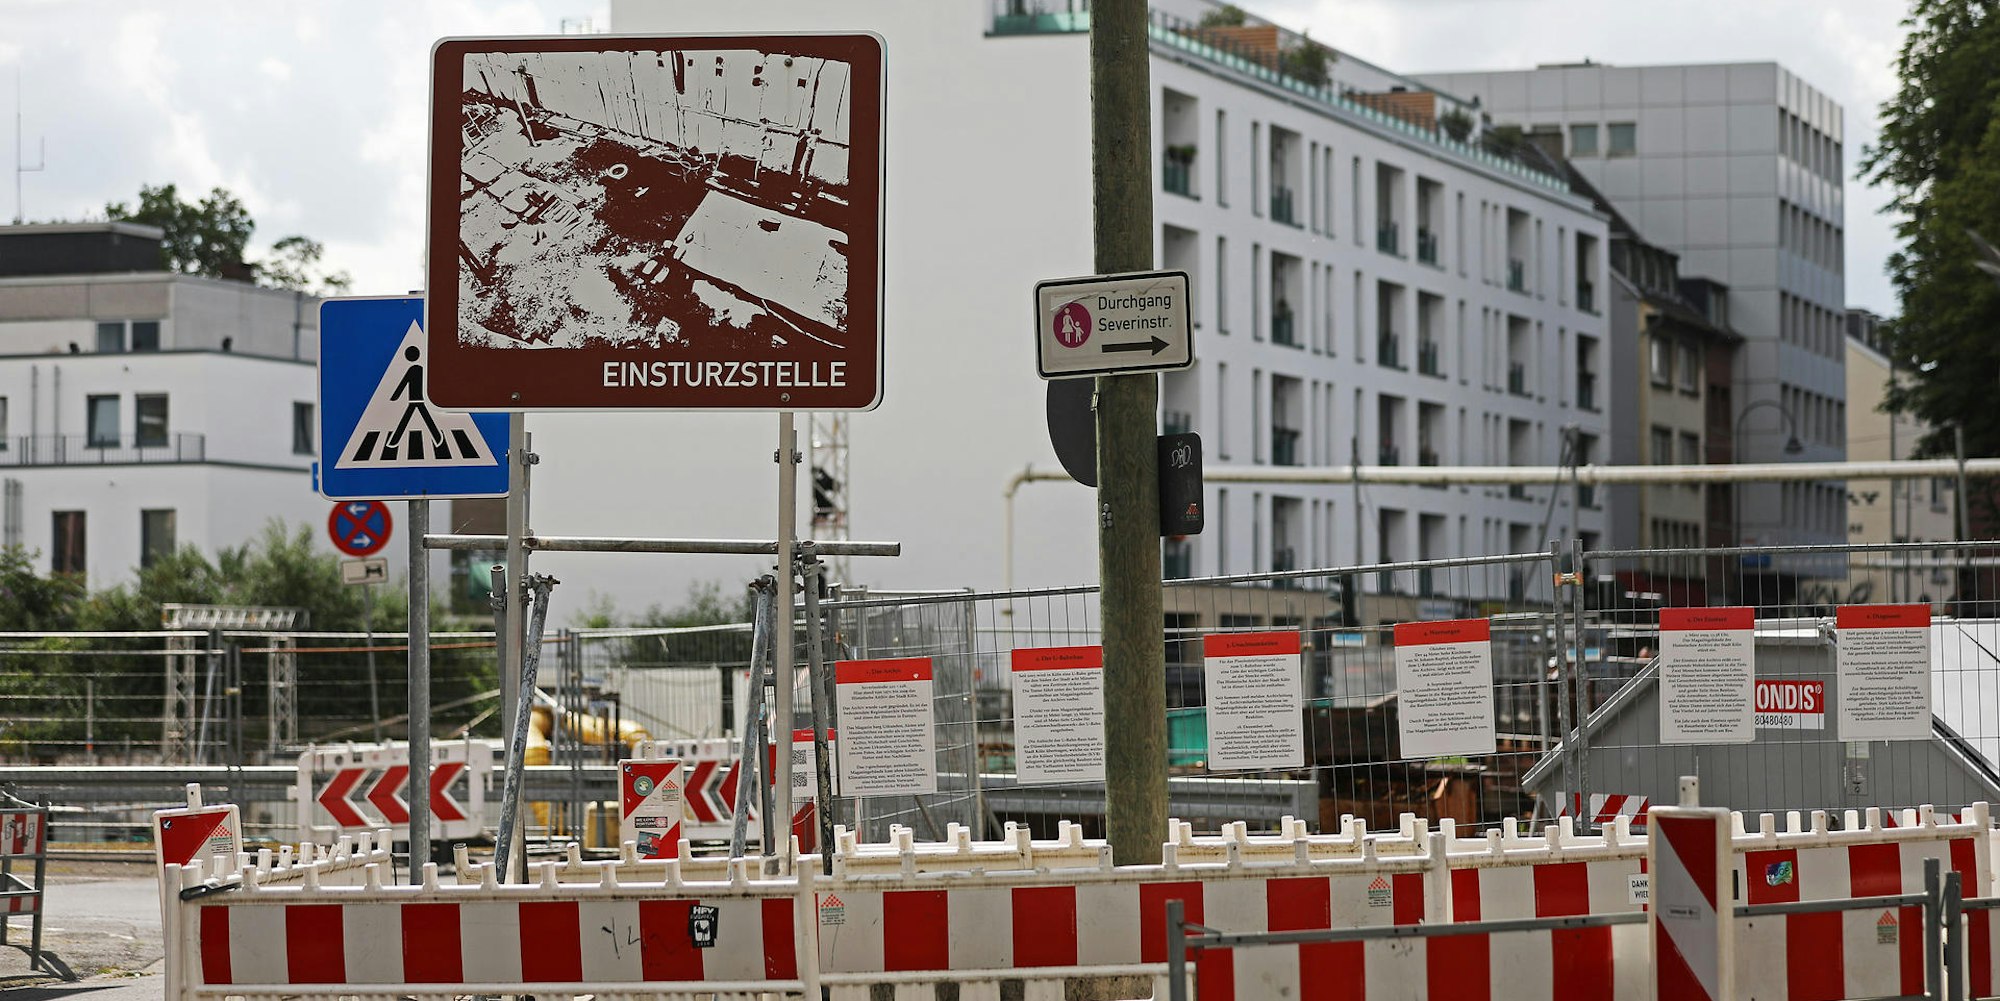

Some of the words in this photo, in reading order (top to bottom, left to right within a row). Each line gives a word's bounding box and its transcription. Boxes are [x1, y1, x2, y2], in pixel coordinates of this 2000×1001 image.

[1098, 295, 1171, 312] Durchgang
[1098, 315, 1172, 331] Severinstr.
[603, 361, 846, 387] EINSTURZSTELLE
